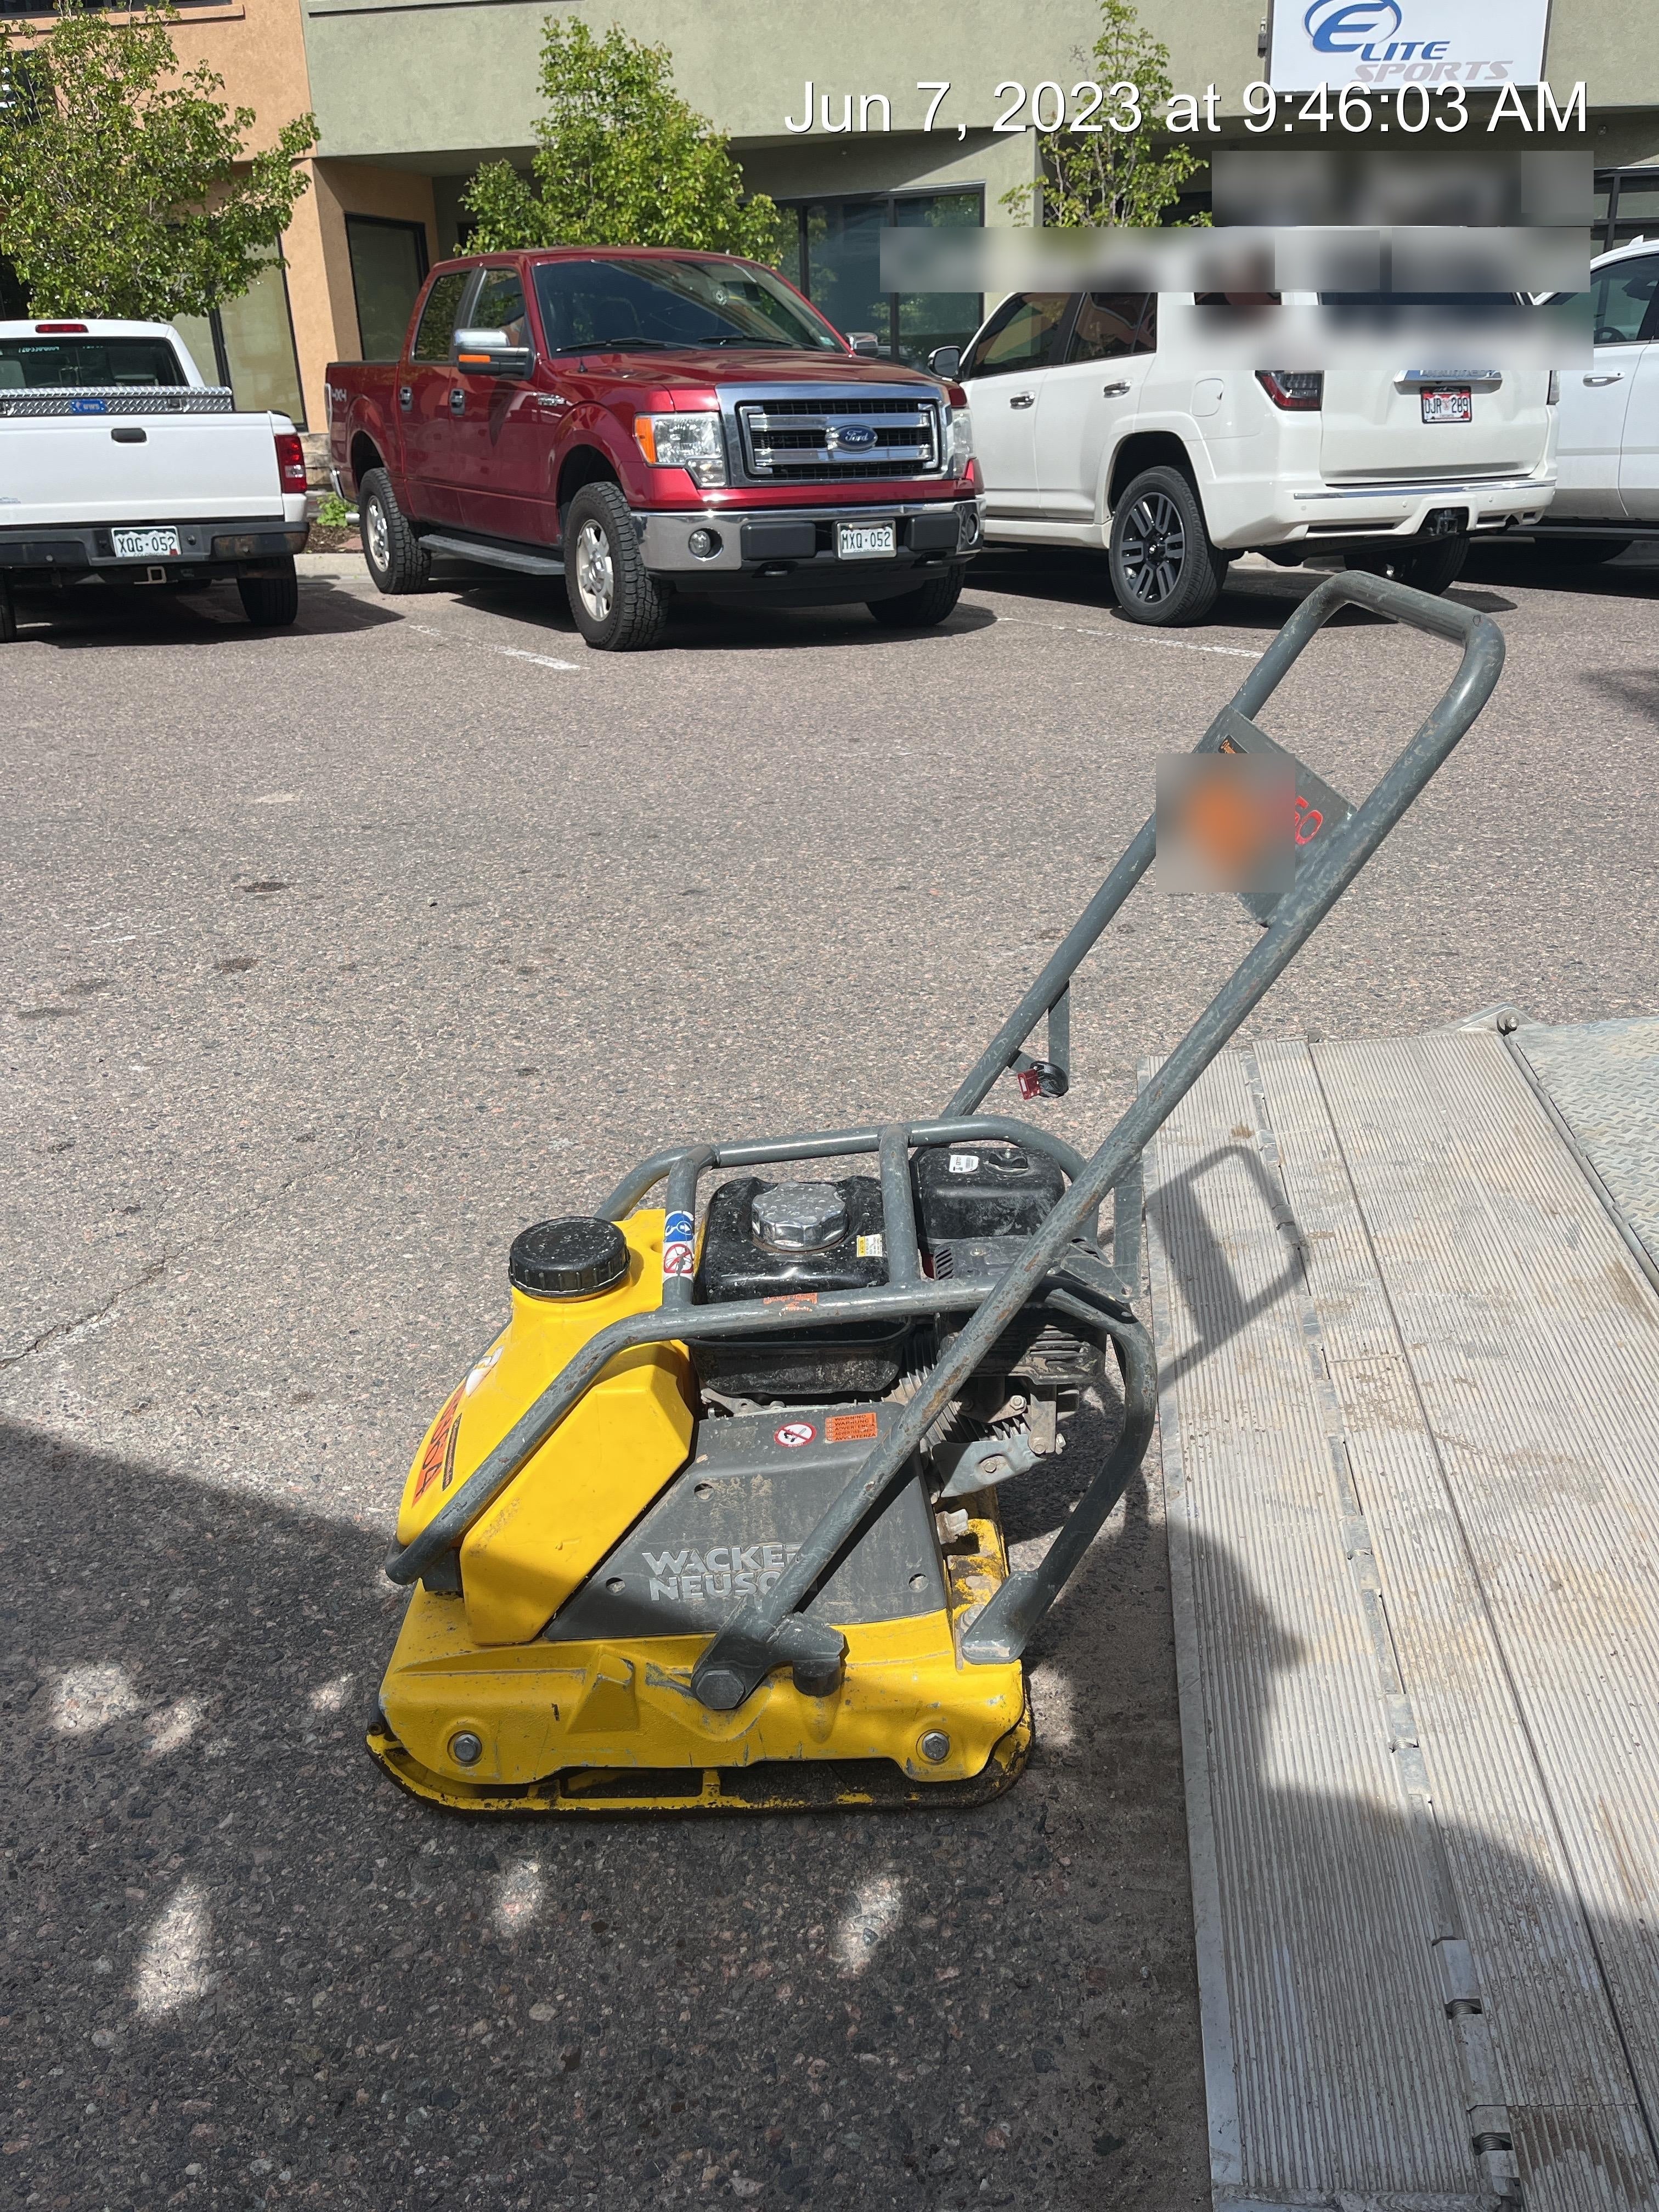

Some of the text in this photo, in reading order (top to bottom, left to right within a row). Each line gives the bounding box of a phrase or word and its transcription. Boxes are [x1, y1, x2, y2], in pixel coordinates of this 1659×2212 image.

[1312, 2, 1451, 62] ELITE
[1350, 60, 1514, 83] SPORTS
[845, 430, 869, 442] Ford
[648, 1571, 782, 1601] NEUSO
